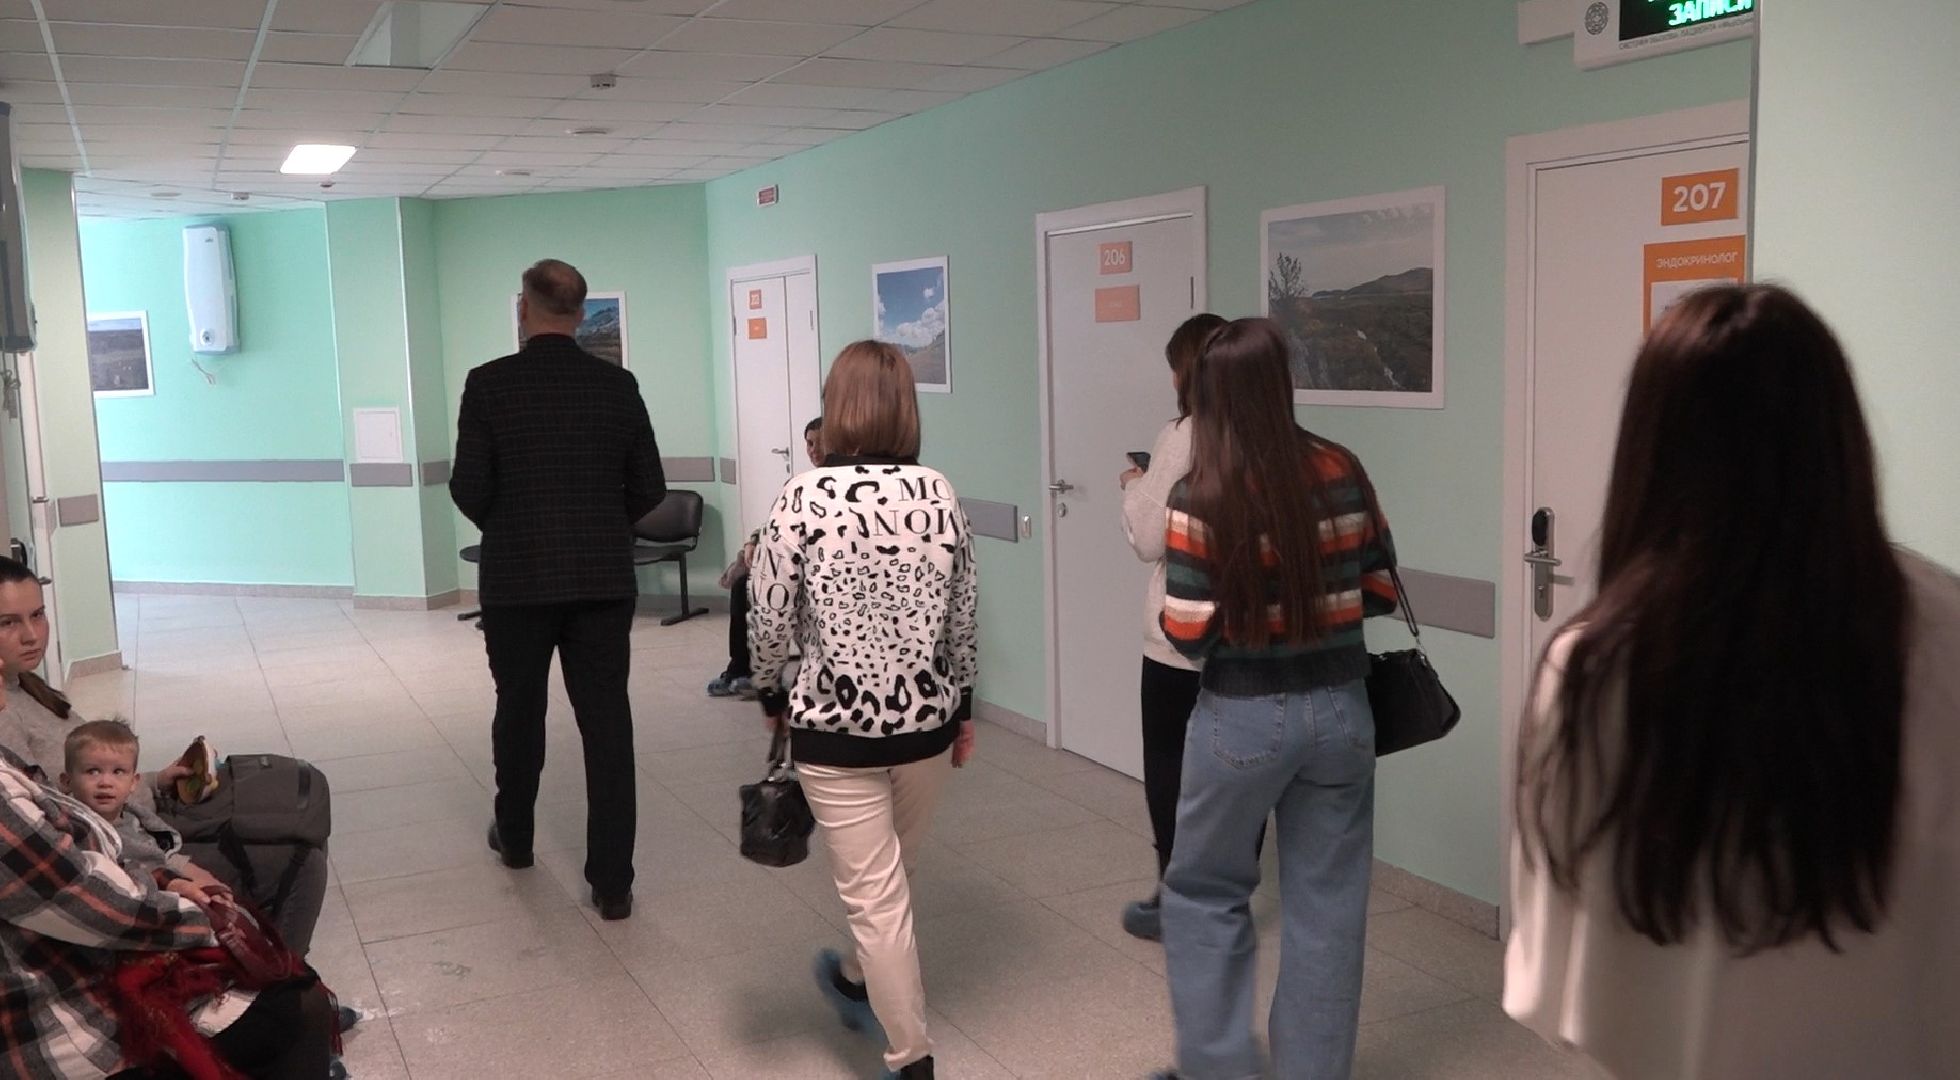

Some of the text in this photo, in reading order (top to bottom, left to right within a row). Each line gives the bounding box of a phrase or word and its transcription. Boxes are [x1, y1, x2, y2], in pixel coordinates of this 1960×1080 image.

[1673, 182, 1726, 213] 207
[1103, 249, 1126, 266] 206
[1656, 251, 1738, 268] ЭНДОКРИНОЛОГ
